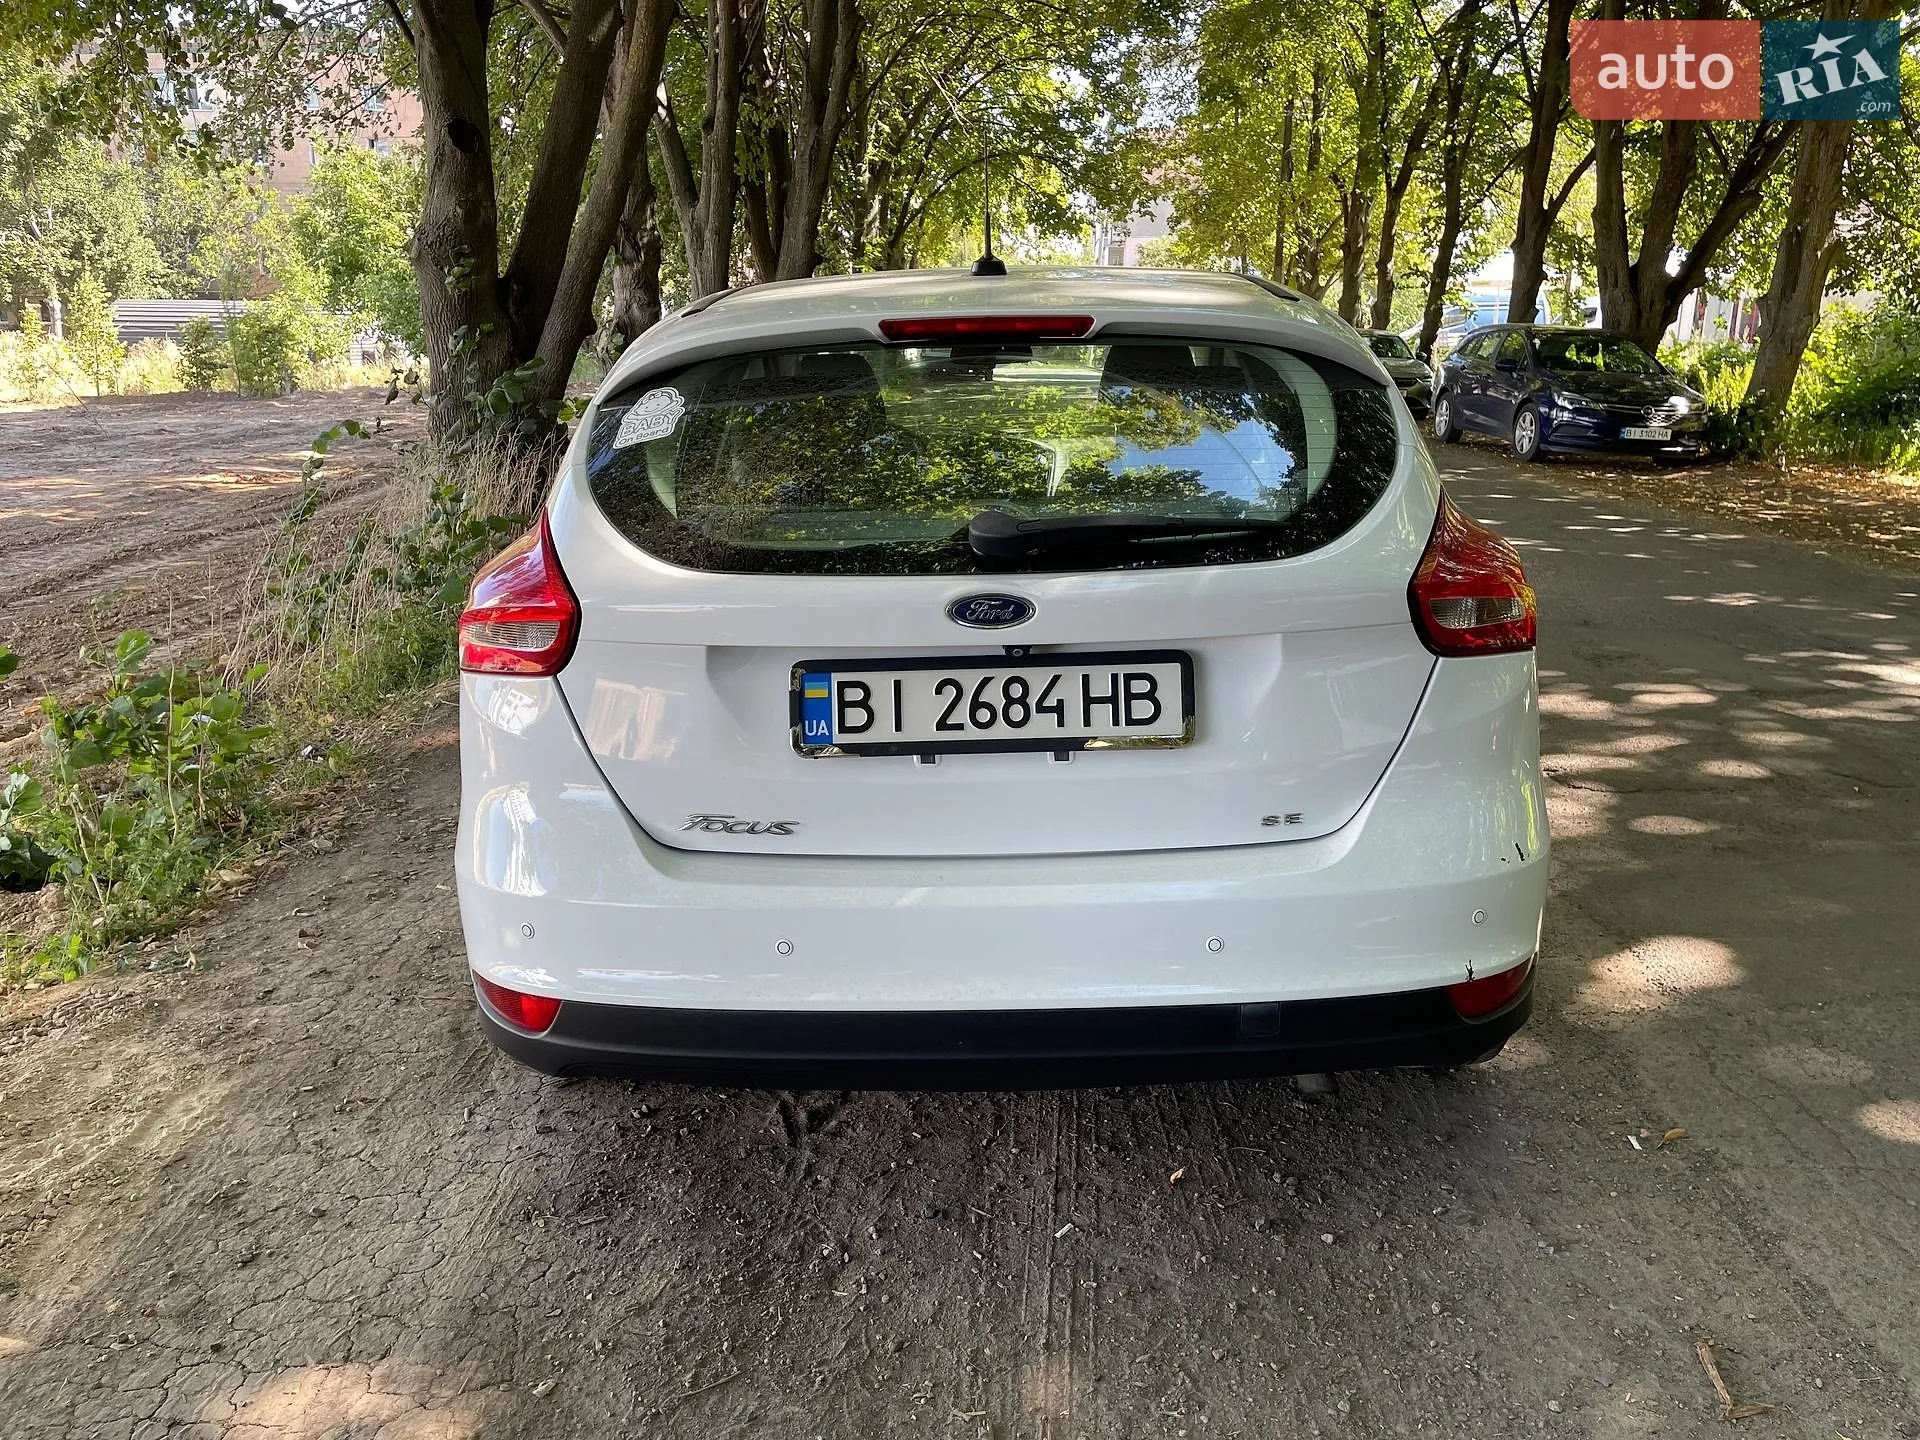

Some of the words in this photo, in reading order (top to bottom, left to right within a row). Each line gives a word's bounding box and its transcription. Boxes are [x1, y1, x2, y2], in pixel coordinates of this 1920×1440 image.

[966, 600, 1015, 621] Ford
[934, 675, 1065, 732] 2684
[1081, 672, 1163, 728] HB
[805, 719, 830, 736] UA
[1261, 813, 1304, 826] SE
